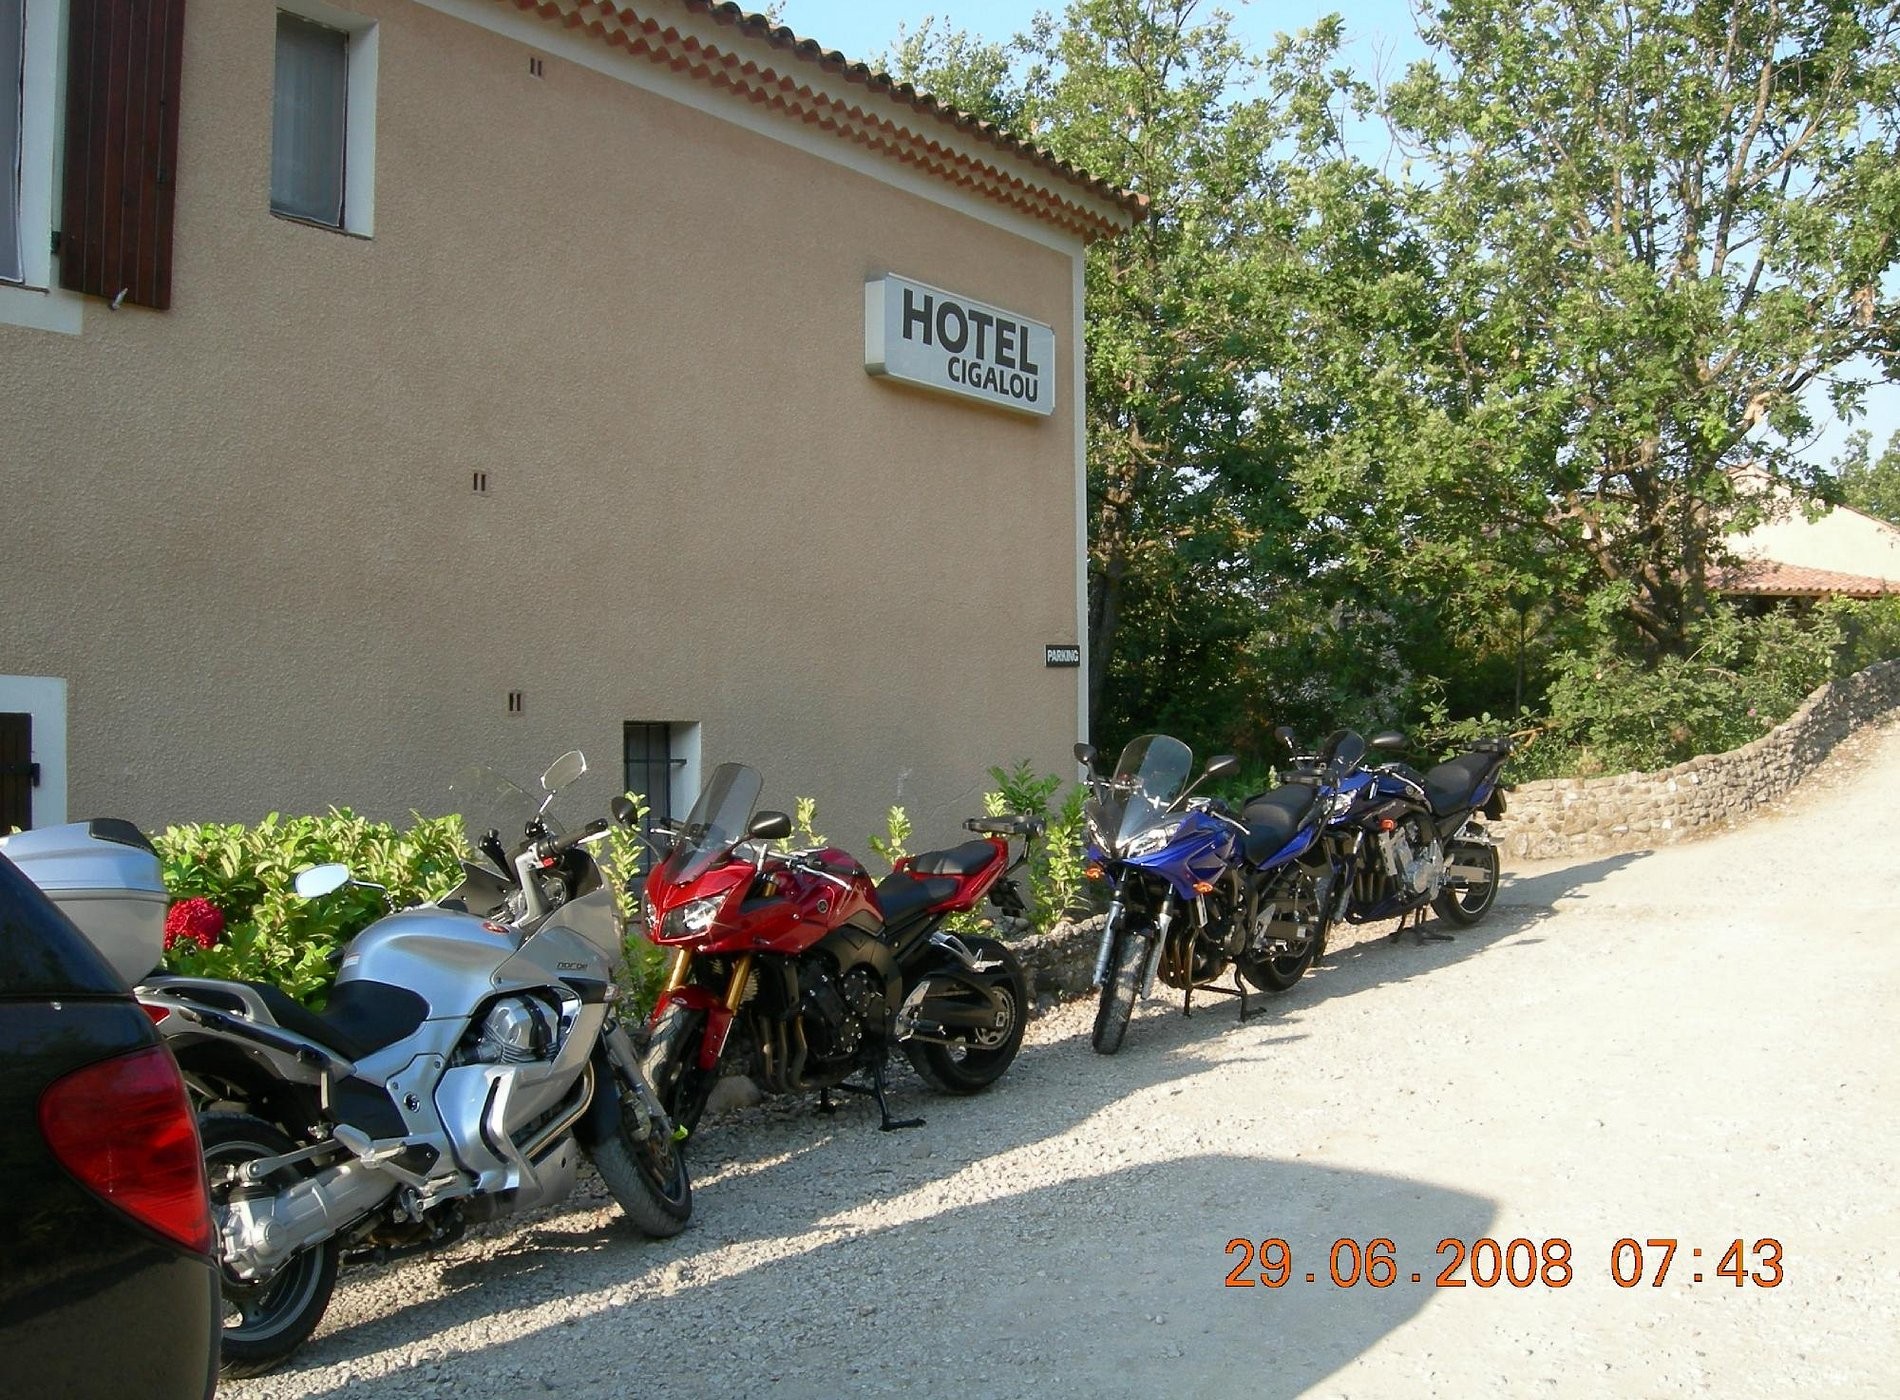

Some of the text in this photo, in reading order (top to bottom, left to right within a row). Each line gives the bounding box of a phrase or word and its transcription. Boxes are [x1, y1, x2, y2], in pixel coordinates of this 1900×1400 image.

[903, 288, 1039, 376] HOTEL
[947, 356, 1038, 402] CIGALOU
[1047, 649, 1079, 662] PARKING
